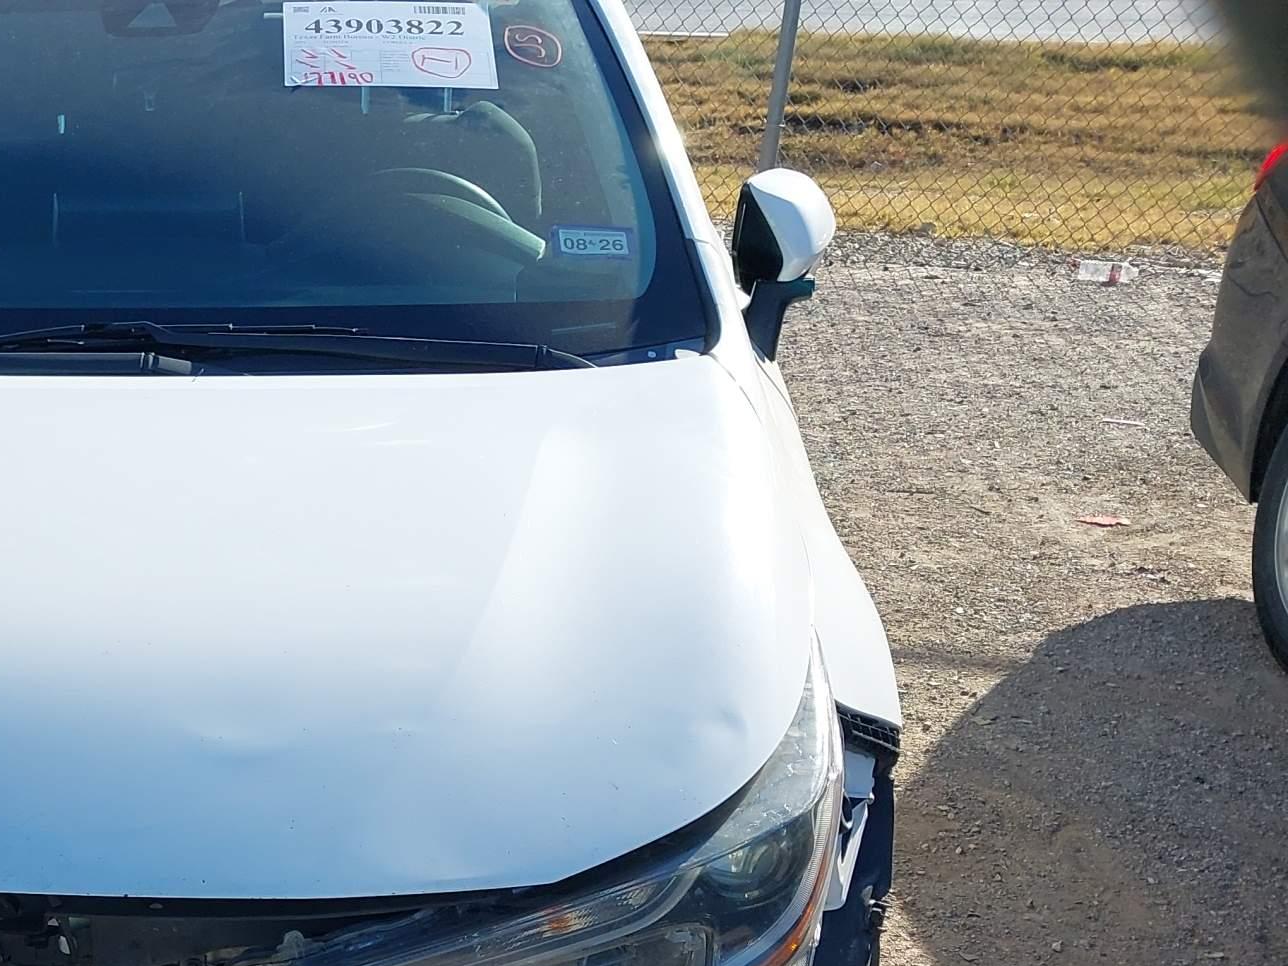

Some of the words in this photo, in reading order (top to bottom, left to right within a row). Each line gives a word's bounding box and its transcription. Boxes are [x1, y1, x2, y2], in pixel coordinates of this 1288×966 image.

[304, 18, 465, 36] 43903822
[563, 237, 588, 251] 08
[599, 238, 624, 251] 26
